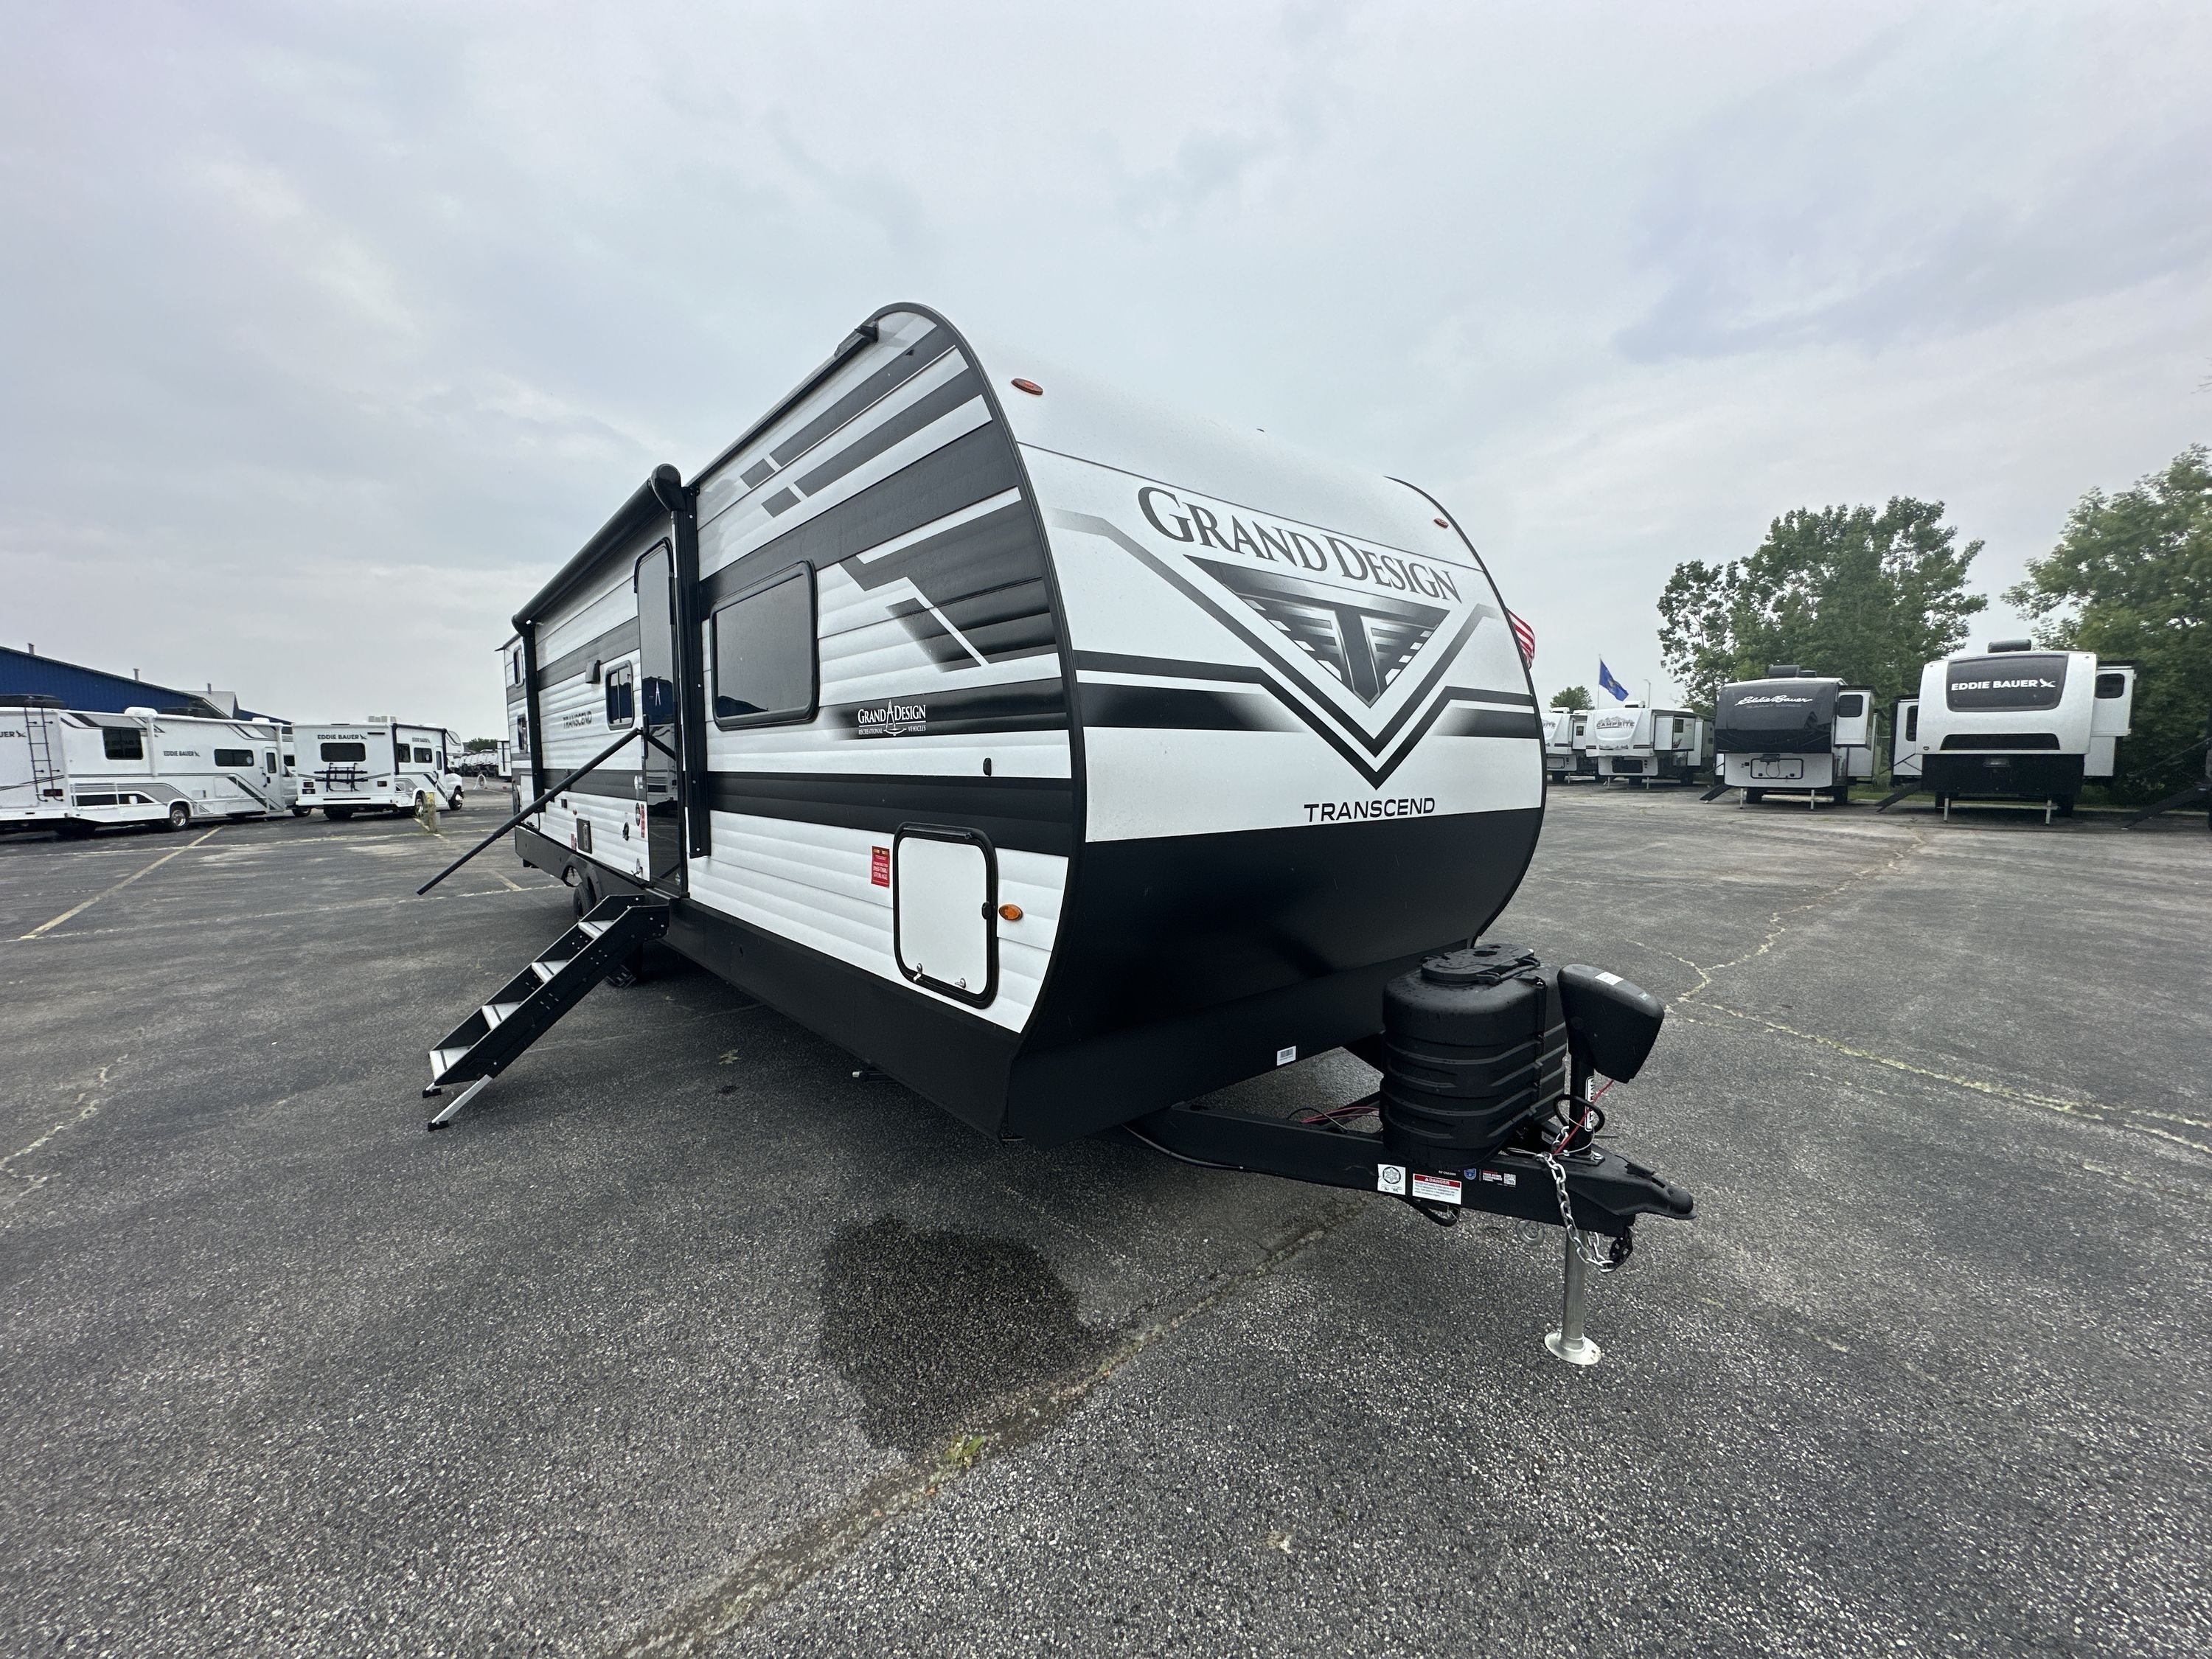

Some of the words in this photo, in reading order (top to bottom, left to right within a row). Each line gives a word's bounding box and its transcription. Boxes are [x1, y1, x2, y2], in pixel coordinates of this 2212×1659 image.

[1138, 486, 1328, 572] GRAND
[1320, 534, 1462, 605] DESIGN
[1951, 681, 1991, 691] EDDIE
[1993, 679, 2038, 689] BAUER
[1734, 696, 1771, 706] Eddie
[1771, 695, 1813, 703] Bauer
[858, 709, 886, 724] GRAND
[894, 704, 927, 721] DESIGN
[908, 724, 927, 732] VEHICLES
[1304, 797, 1436, 823] TRANSCEND
[1429, 1178, 1450, 1186] DANGER
